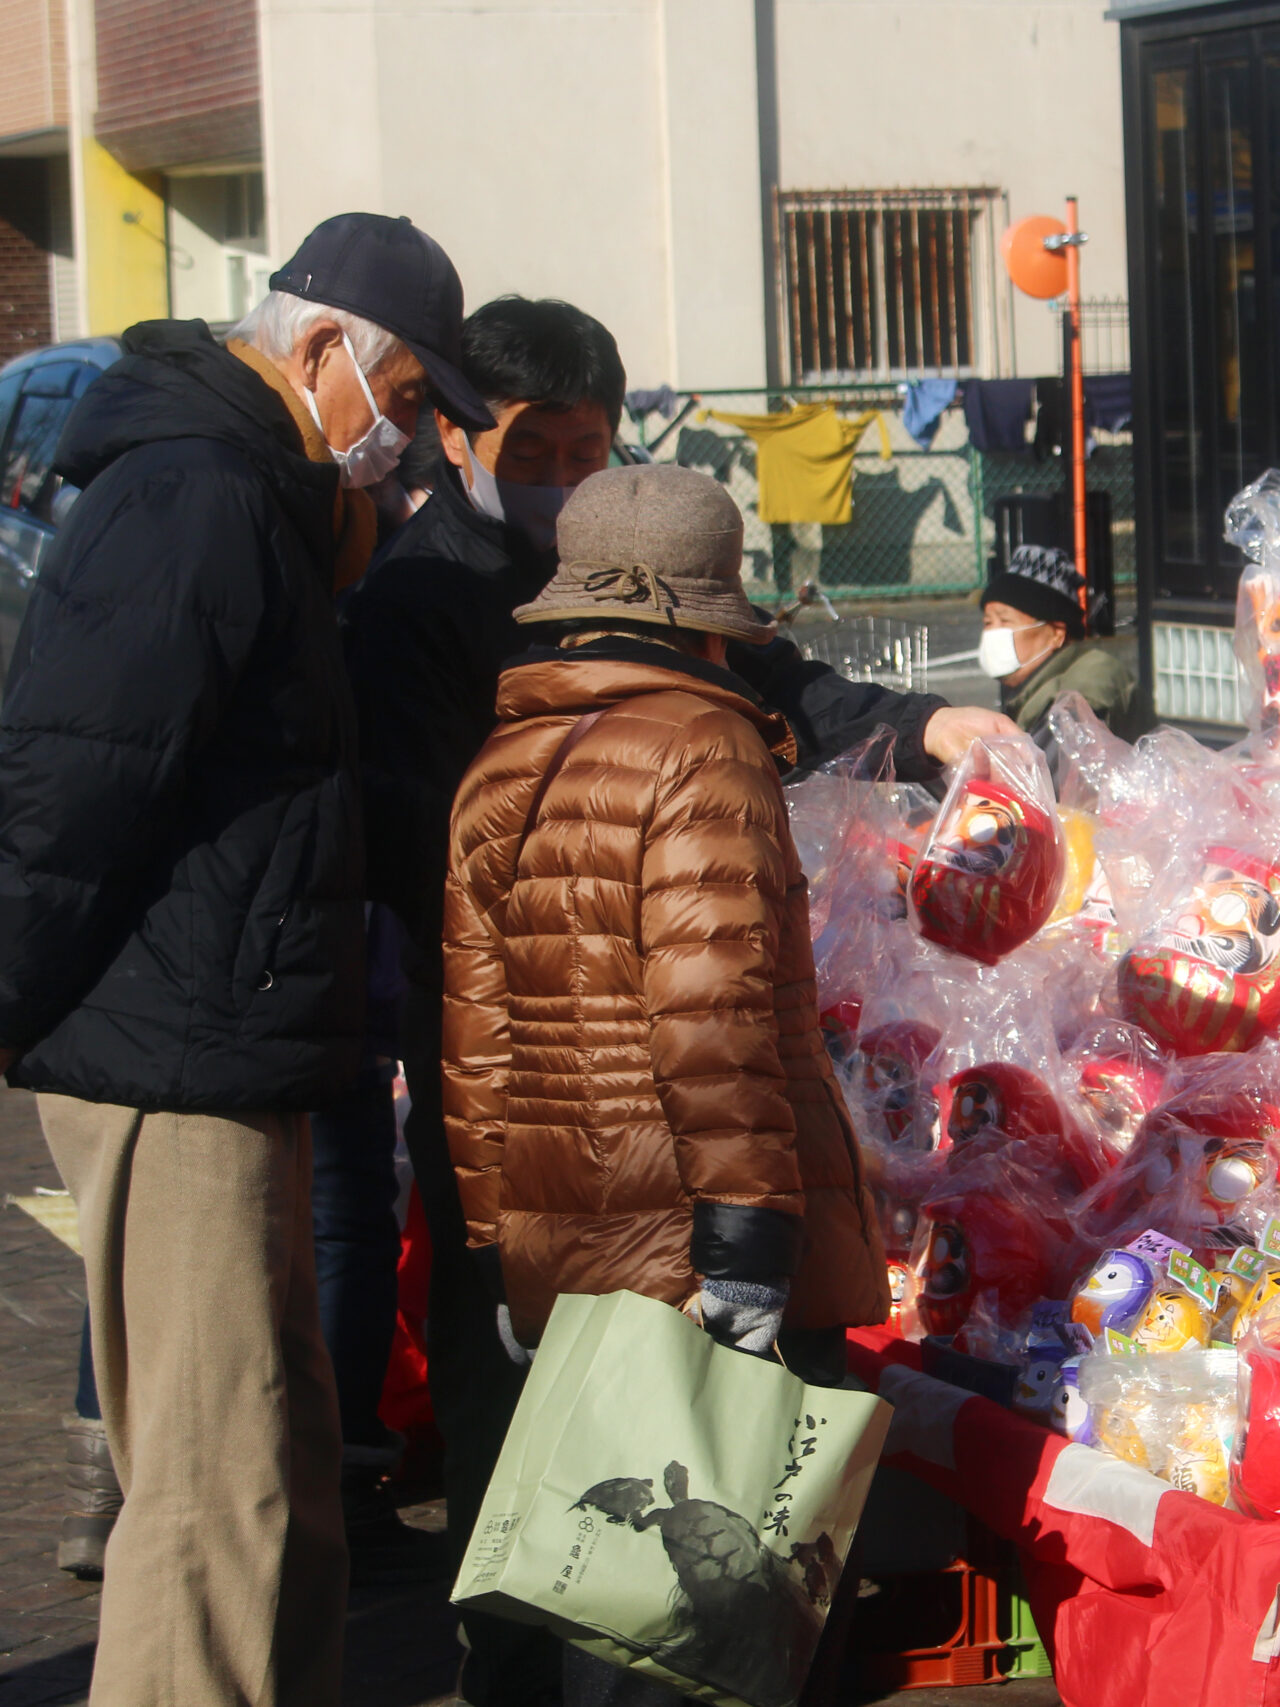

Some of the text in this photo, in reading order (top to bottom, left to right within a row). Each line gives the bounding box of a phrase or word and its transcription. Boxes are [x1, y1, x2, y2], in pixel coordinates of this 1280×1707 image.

[763, 1414, 827, 1537] 小江戸の味
